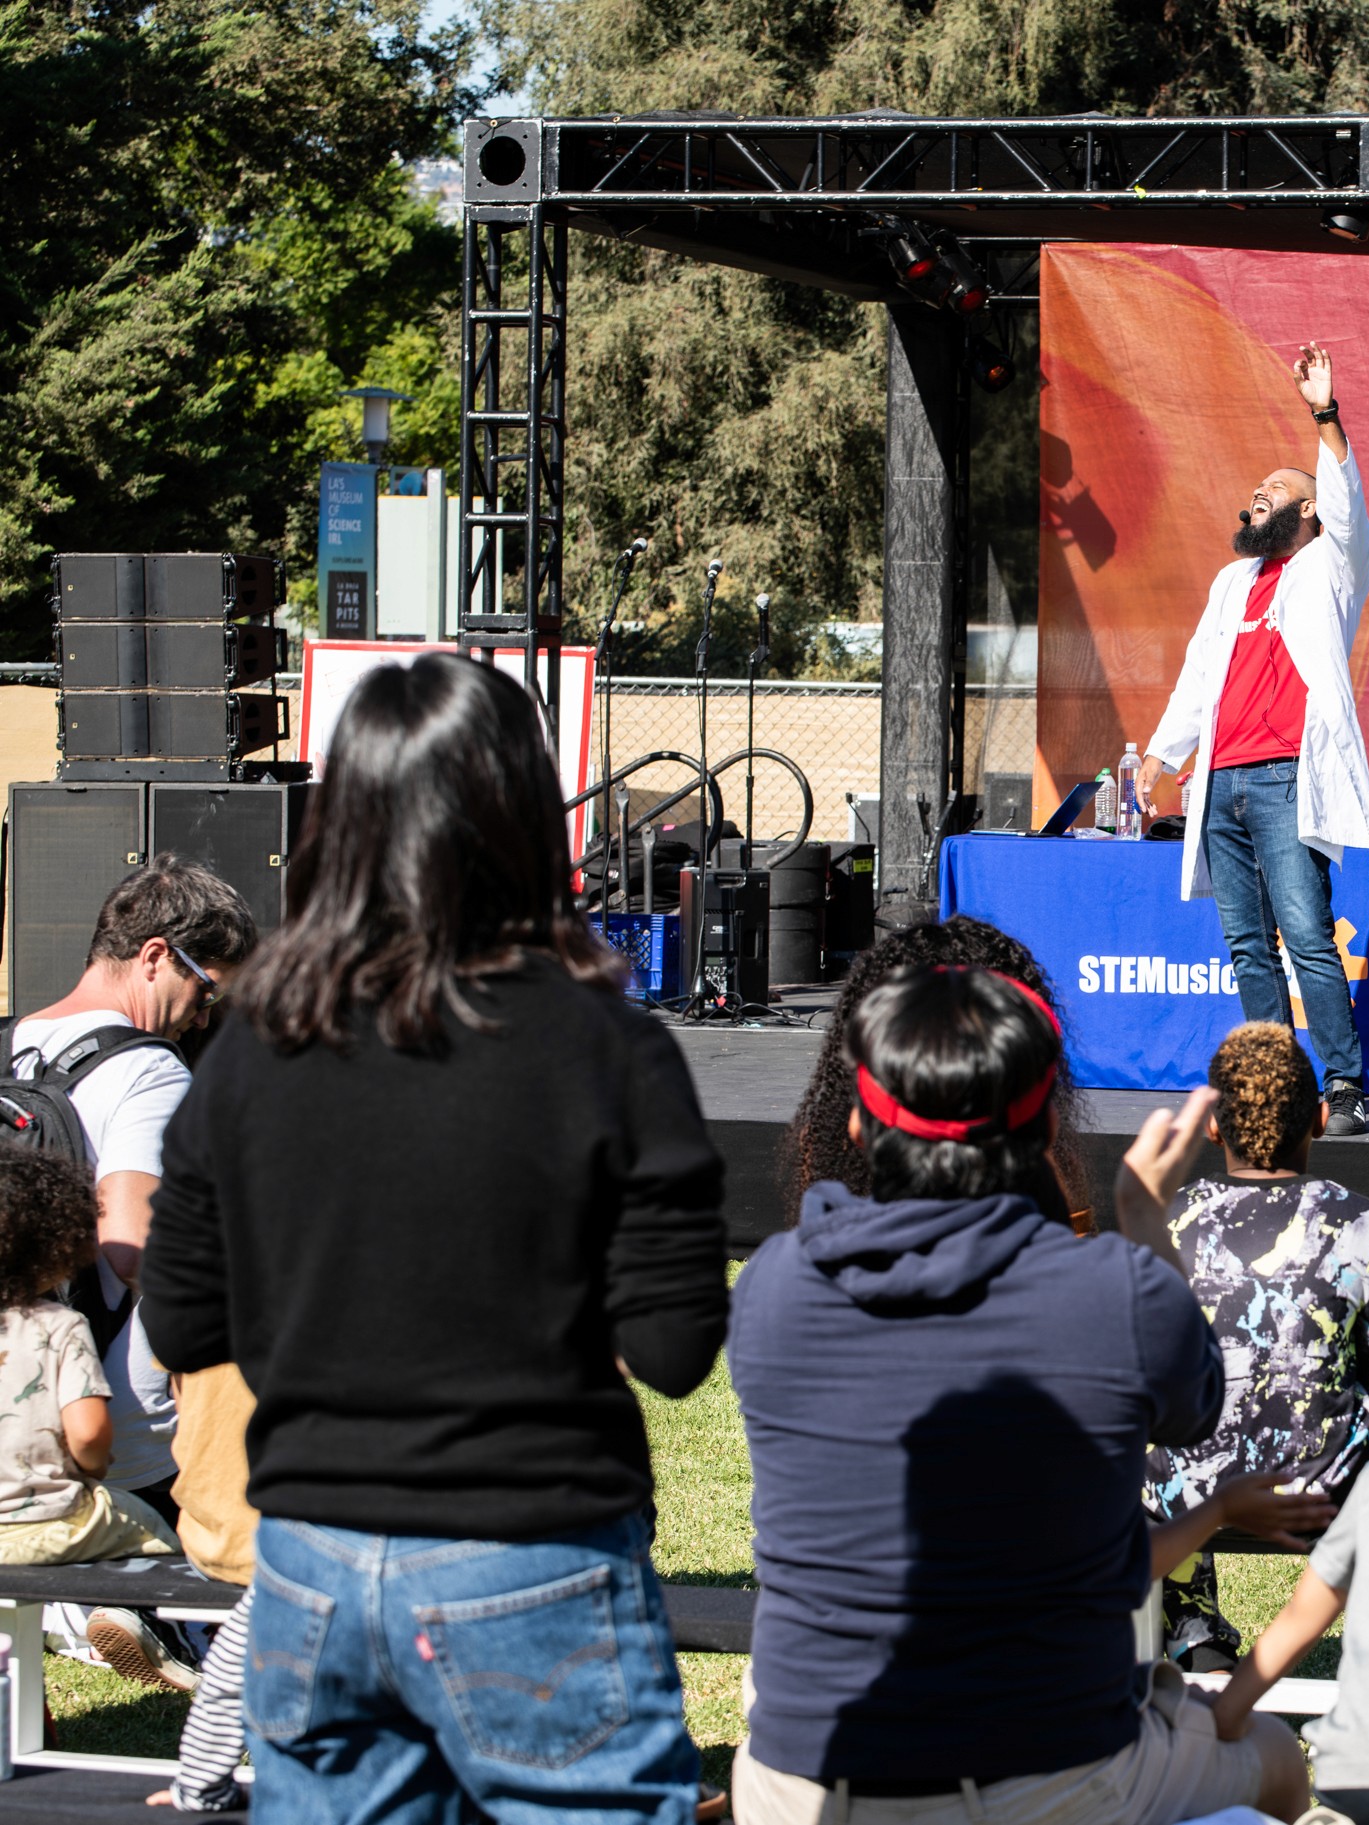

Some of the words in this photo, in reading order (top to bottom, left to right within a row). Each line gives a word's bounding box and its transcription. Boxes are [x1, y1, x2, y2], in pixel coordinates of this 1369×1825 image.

[328, 491, 363, 504] MUSEUM
[328, 504, 340, 517] OF
[328, 519, 362, 532] SCIENCE
[328, 533, 342, 545] IRL
[336, 592, 360, 605] TAR
[336, 607, 360, 621] PITS
[1078, 955, 1240, 995] STEMusic
